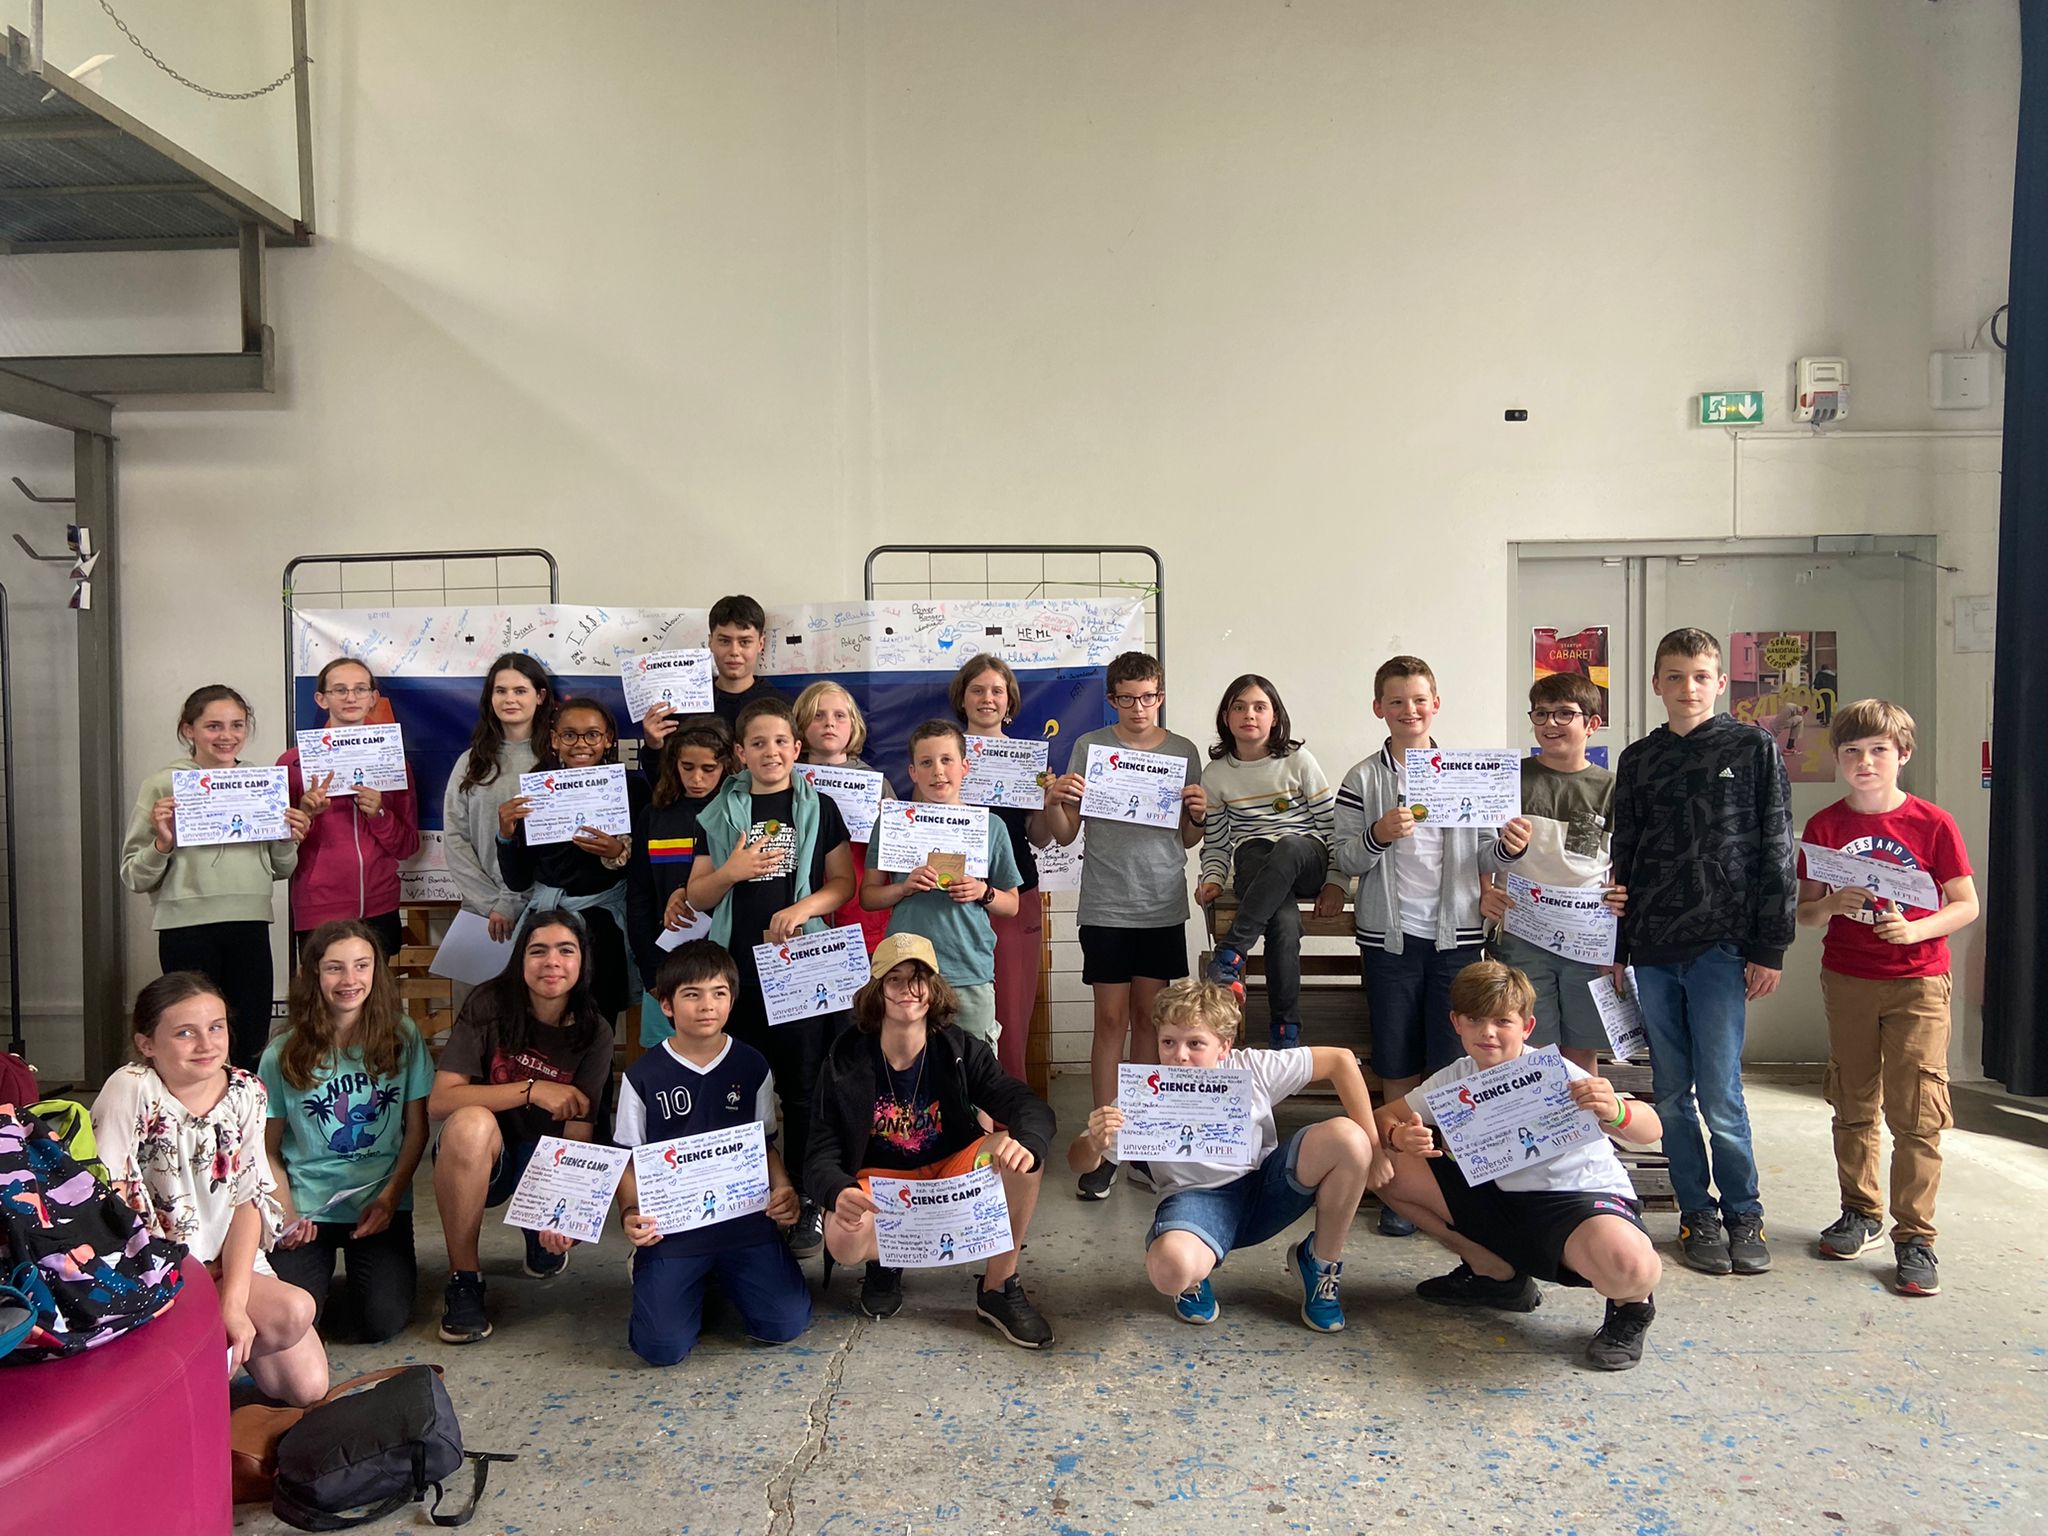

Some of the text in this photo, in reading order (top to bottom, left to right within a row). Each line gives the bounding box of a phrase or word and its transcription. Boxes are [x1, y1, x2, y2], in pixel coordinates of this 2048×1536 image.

[639, 656, 672, 673] SCIENCE
[1549, 649, 1594, 660] CABARET
[322, 734, 385, 751] SCIENCE CAMP
[973, 741, 1031, 759] SCIENCE CAMP
[1109, 754, 1145, 772] SCIENCE
[1146, 766, 1169, 775] CAMP
[1431, 754, 1473, 773] SCIENCE
[1474, 762, 1500, 771] CAMP
[200, 774, 270, 794] SCIENCE CAMP
[544, 777, 609, 793] SCIENCE CAMP
[805, 771, 866, 791] SCIENCE CAMP
[905, 807, 944, 824] SCIENCE
[946, 818, 971, 826] CAMP
[1846, 841, 1870, 854] CES
[1876, 839, 1903, 854] AND
[1530, 888, 1600, 910] SCIENCE CAMP
[780, 942, 846, 966] SCIENCE CAMP
[509, 1054, 558, 1078] ublime
[326, 1073, 378, 1103] NOP
[1147, 1072, 1196, 1095] SCIENCE
[1198, 1084, 1228, 1094] CAMP
[1458, 1082, 1511, 1112] SCIENCE
[1512, 1071, 1543, 1090] CAMP
[656, 1085, 692, 1120] 10
[664, 1142, 744, 1169] SCIENCE CAMP
[1123, 1141, 1167, 1152] université
[553, 1147, 588, 1169] SCIENCE
[586, 1160, 609, 1172] CAMP
[1469, 1153, 1514, 1175] université
[899, 1186, 982, 1208] SCIENCE CAMP
[511, 1209, 543, 1220] université
[655, 1215, 692, 1227] niversité
[885, 1248, 928, 1259] université
